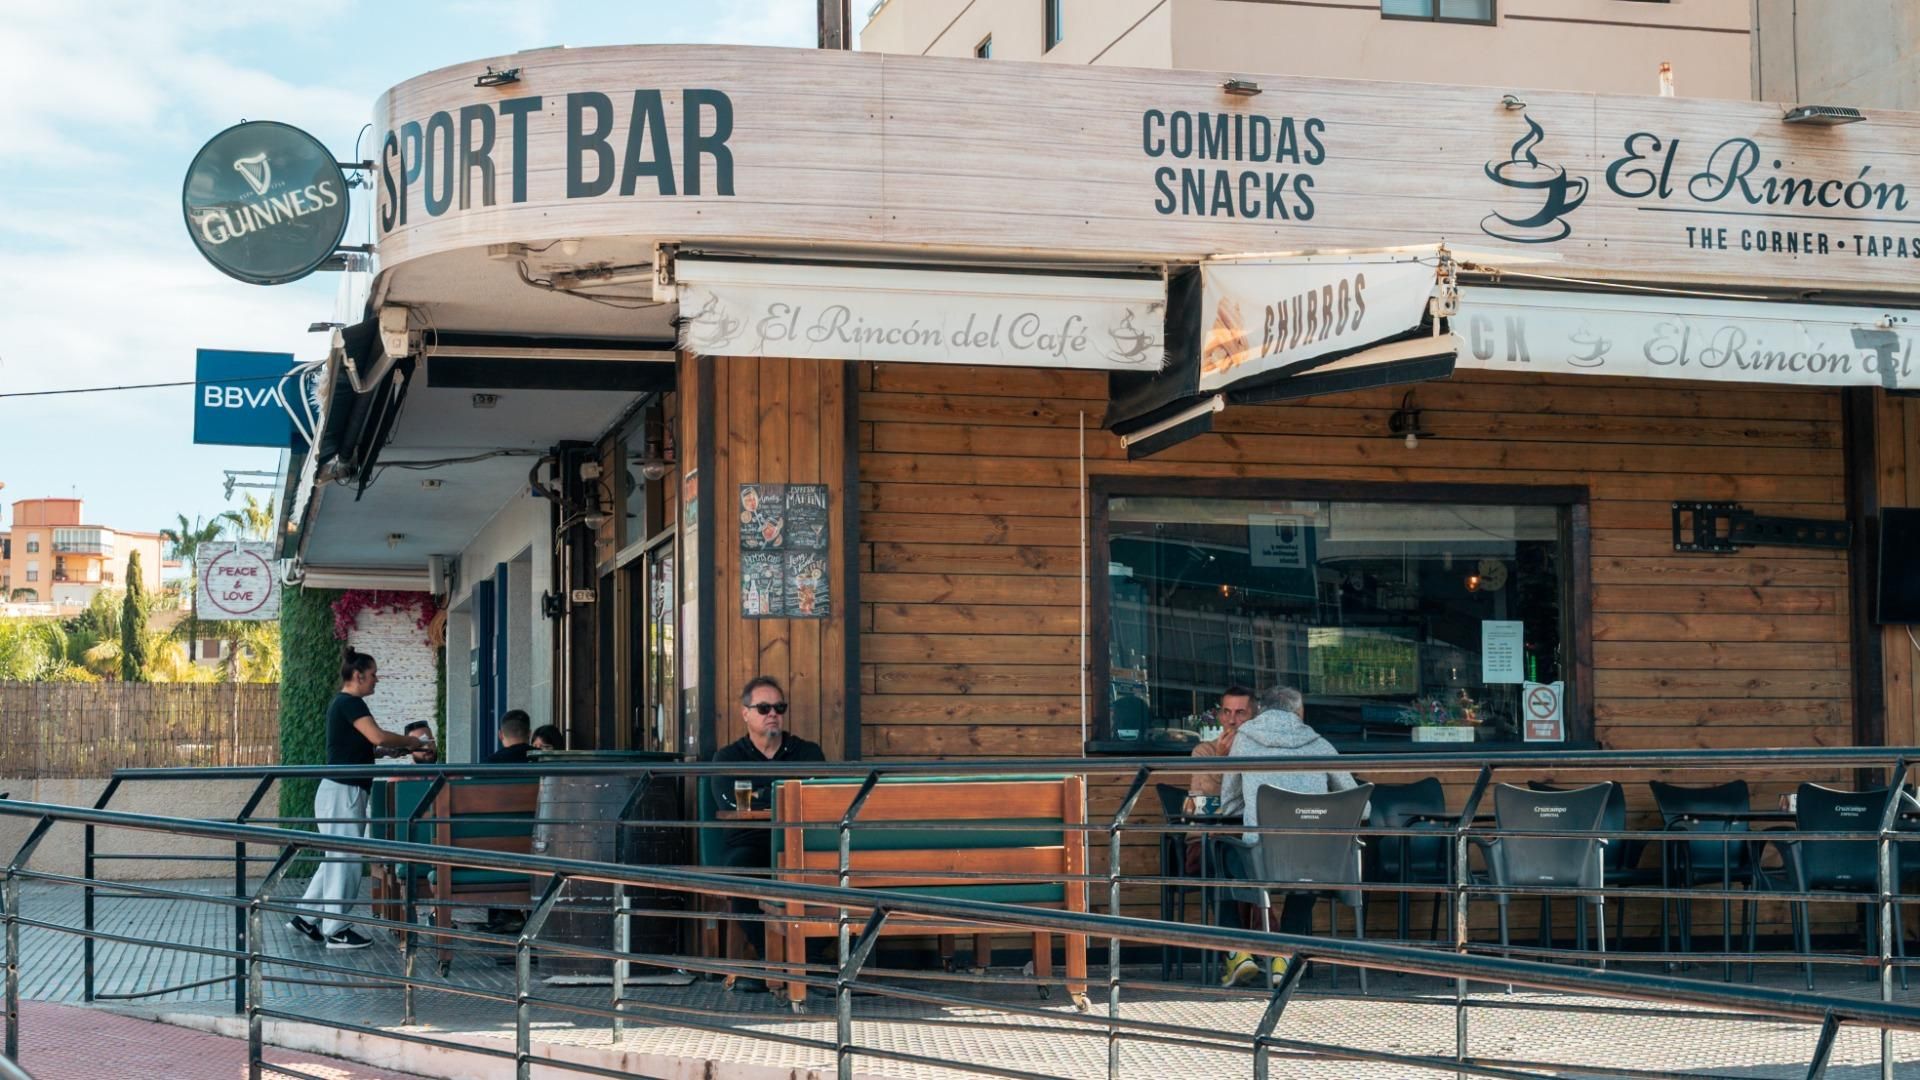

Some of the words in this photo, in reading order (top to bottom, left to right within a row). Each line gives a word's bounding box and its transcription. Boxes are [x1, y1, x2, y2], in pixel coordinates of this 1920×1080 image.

[380, 95, 543, 233] SPORT
[566, 88, 735, 199] BAR
[1143, 109, 1326, 166] COMIDAS
[1154, 166, 1315, 221] SNACKS
[1606, 132, 1680, 199] El
[1688, 137, 1909, 212] Rincón
[202, 181, 338, 245] GUINNESS
[1686, 226, 1727, 250] THE
[1741, 228, 1829, 255] CORNER
[1853, 234, 1920, 260] TAPAS
[756, 302, 801, 343] El
[806, 305, 942, 348] Rincón
[951, 312, 1000, 350] del
[1008, 312, 1088, 358] Café
[1261, 272, 1366, 358] CHURROS
[1643, 321, 1691, 366] El
[1700, 325, 1852, 374] Rincón
[204, 385, 283, 409] BBVA
[218, 566, 258, 576] PEACE
[222, 591, 254, 601] LOVE
